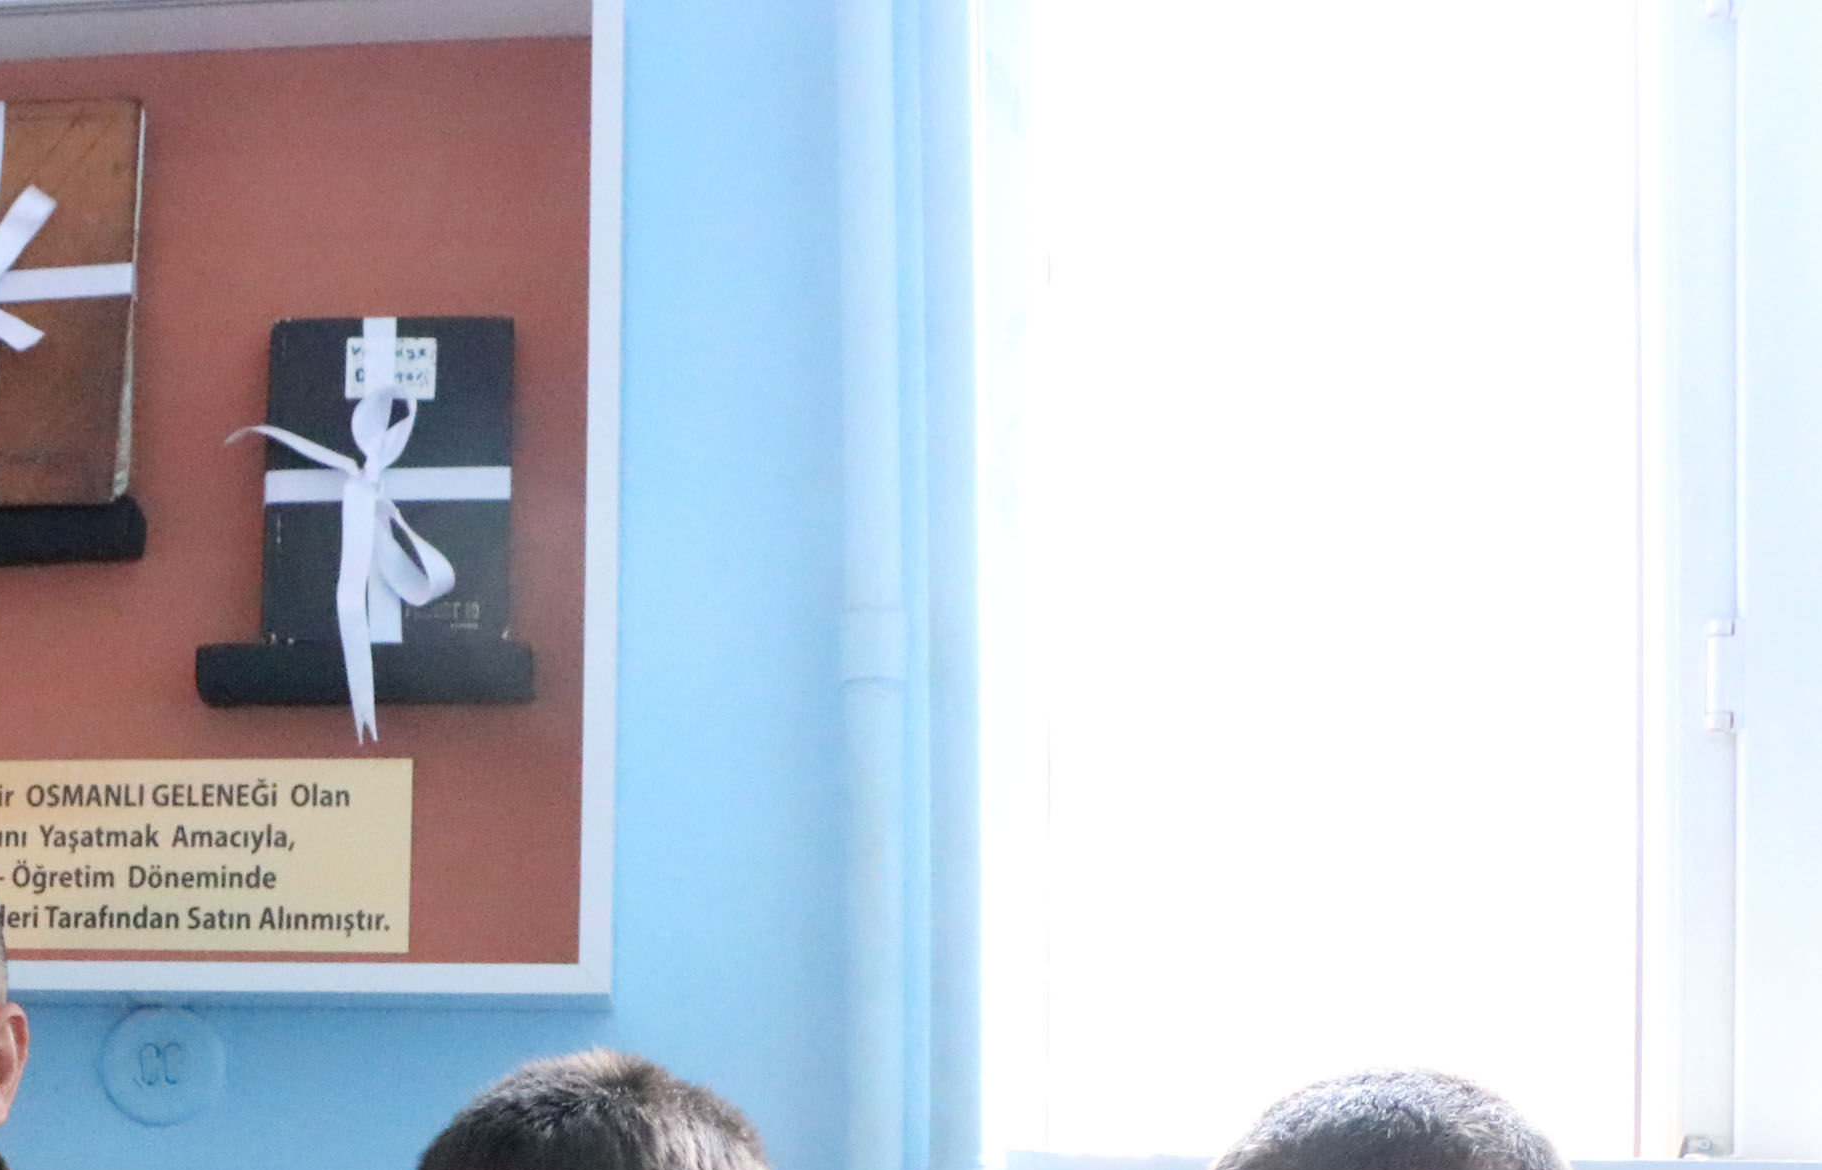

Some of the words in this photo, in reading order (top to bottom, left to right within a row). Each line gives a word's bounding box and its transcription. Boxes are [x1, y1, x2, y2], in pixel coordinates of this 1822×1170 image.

[26, 783, 145, 808] OSMANLI
[290, 783, 351, 808] Olan
[39, 823, 160, 854] Yaşatmak
[172, 823, 296, 854] Amacıyla,
[12, 860, 115, 894] Öğretim
[128, 864, 277, 889] Döneminde
[44, 904, 179, 930] Tarafından
[187, 906, 251, 931] Satın
[258, 906, 391, 937] Alınmıştır.
